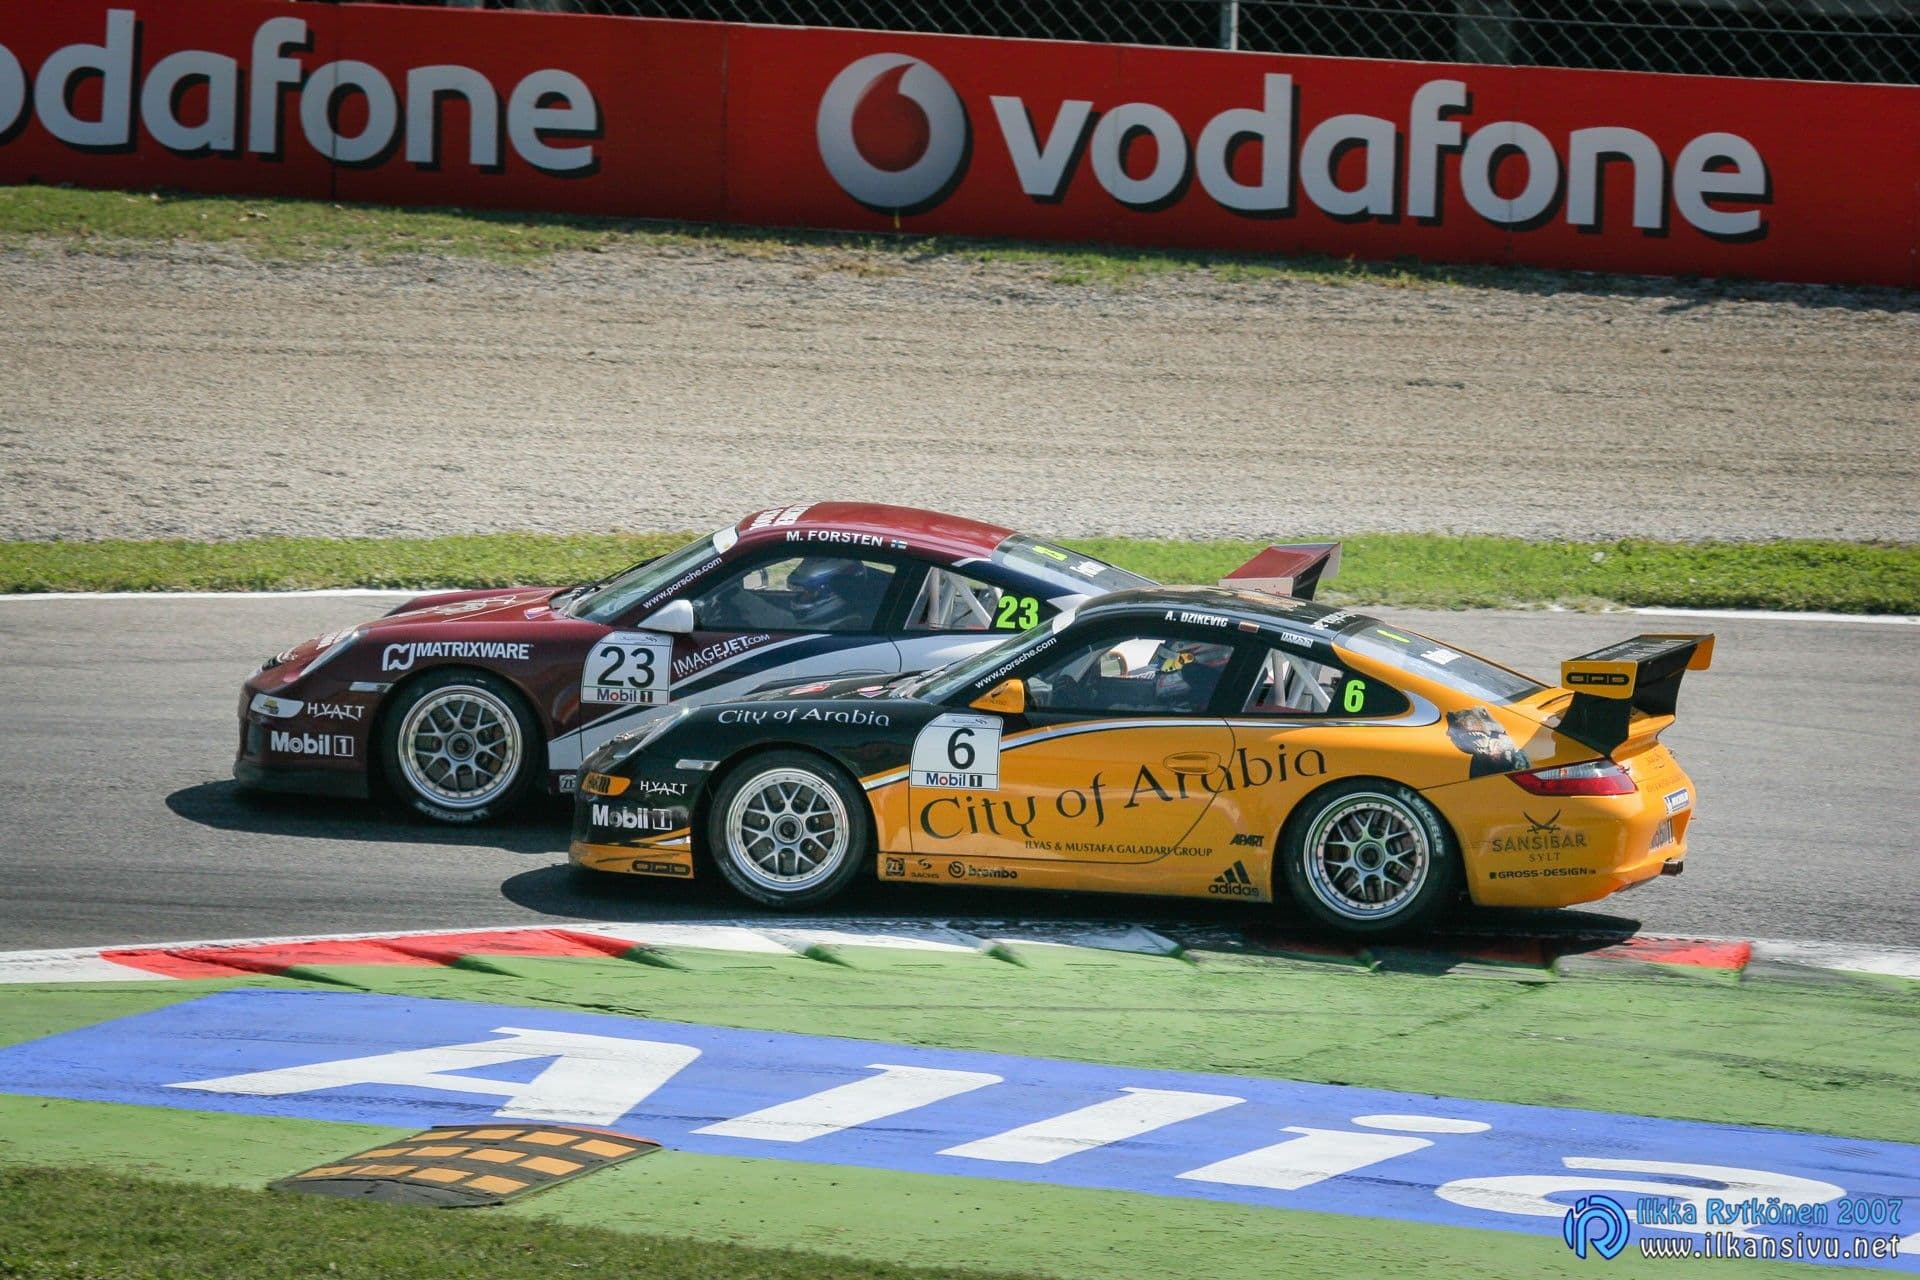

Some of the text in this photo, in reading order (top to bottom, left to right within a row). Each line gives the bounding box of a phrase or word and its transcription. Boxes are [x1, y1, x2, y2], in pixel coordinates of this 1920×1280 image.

[0, 9, 597, 171] dafone
[990, 74, 1765, 235] vodafone
[786, 530, 882, 547] M. FORSTEN
[643, 556, 722, 609] www.porsche.com
[996, 596, 1039, 630] 23
[416, 641, 530, 660] MATRIXWARE
[597, 646, 655, 688] 23
[975, 637, 1057, 689] www.porsche.com
[597, 688, 637, 703] Mobil
[1343, 680, 1365, 713] 6
[307, 702, 365, 719] HYATT
[718, 704, 890, 726] City of Arabia
[270, 730, 331, 756] Mobil
[947, 728, 976, 769] 6
[640, 780, 688, 796] HYATT
[926, 773, 966, 786] Mobil
[920, 743, 1327, 840] City of Arabia
[592, 804, 649, 829] Mobil
[1025, 840, 1213, 857] ILYAS & MUSTAFA GALADARI GROUP
[1492, 833, 1588, 852] SANSIBAR
[968, 865, 1018, 879] brembo
[1498, 867, 1588, 879] GROSS-DESIGN
[1208, 883, 1259, 896] adidas
[163, 1026, 1920, 1256] Allia
